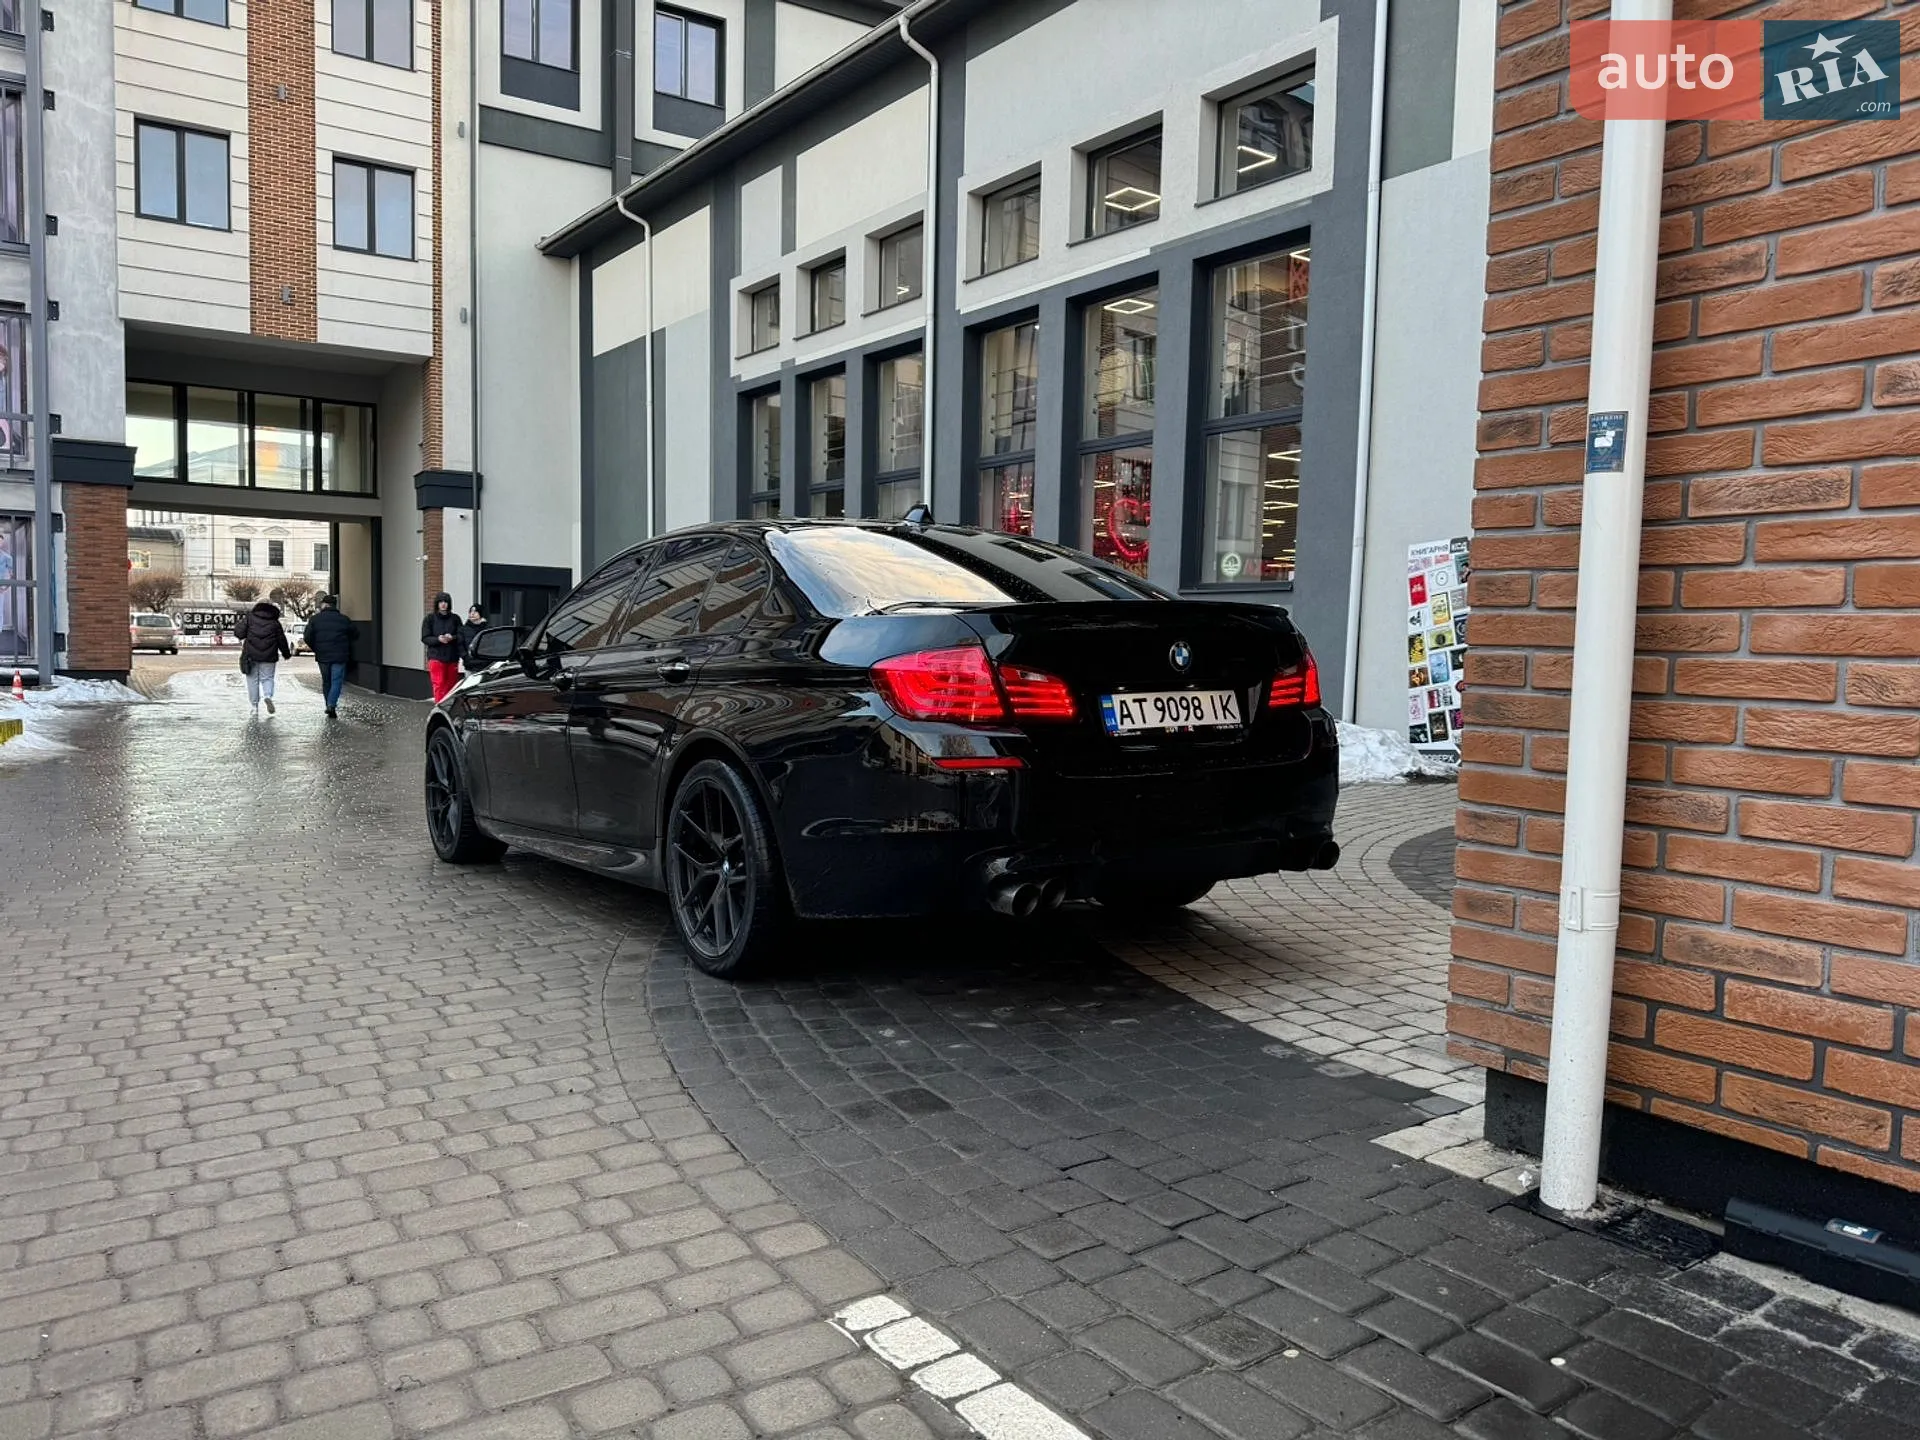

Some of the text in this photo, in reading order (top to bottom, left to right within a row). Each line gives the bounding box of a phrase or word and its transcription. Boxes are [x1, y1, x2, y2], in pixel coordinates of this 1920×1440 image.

[1119, 694, 1237, 726] AT 9098 IK
